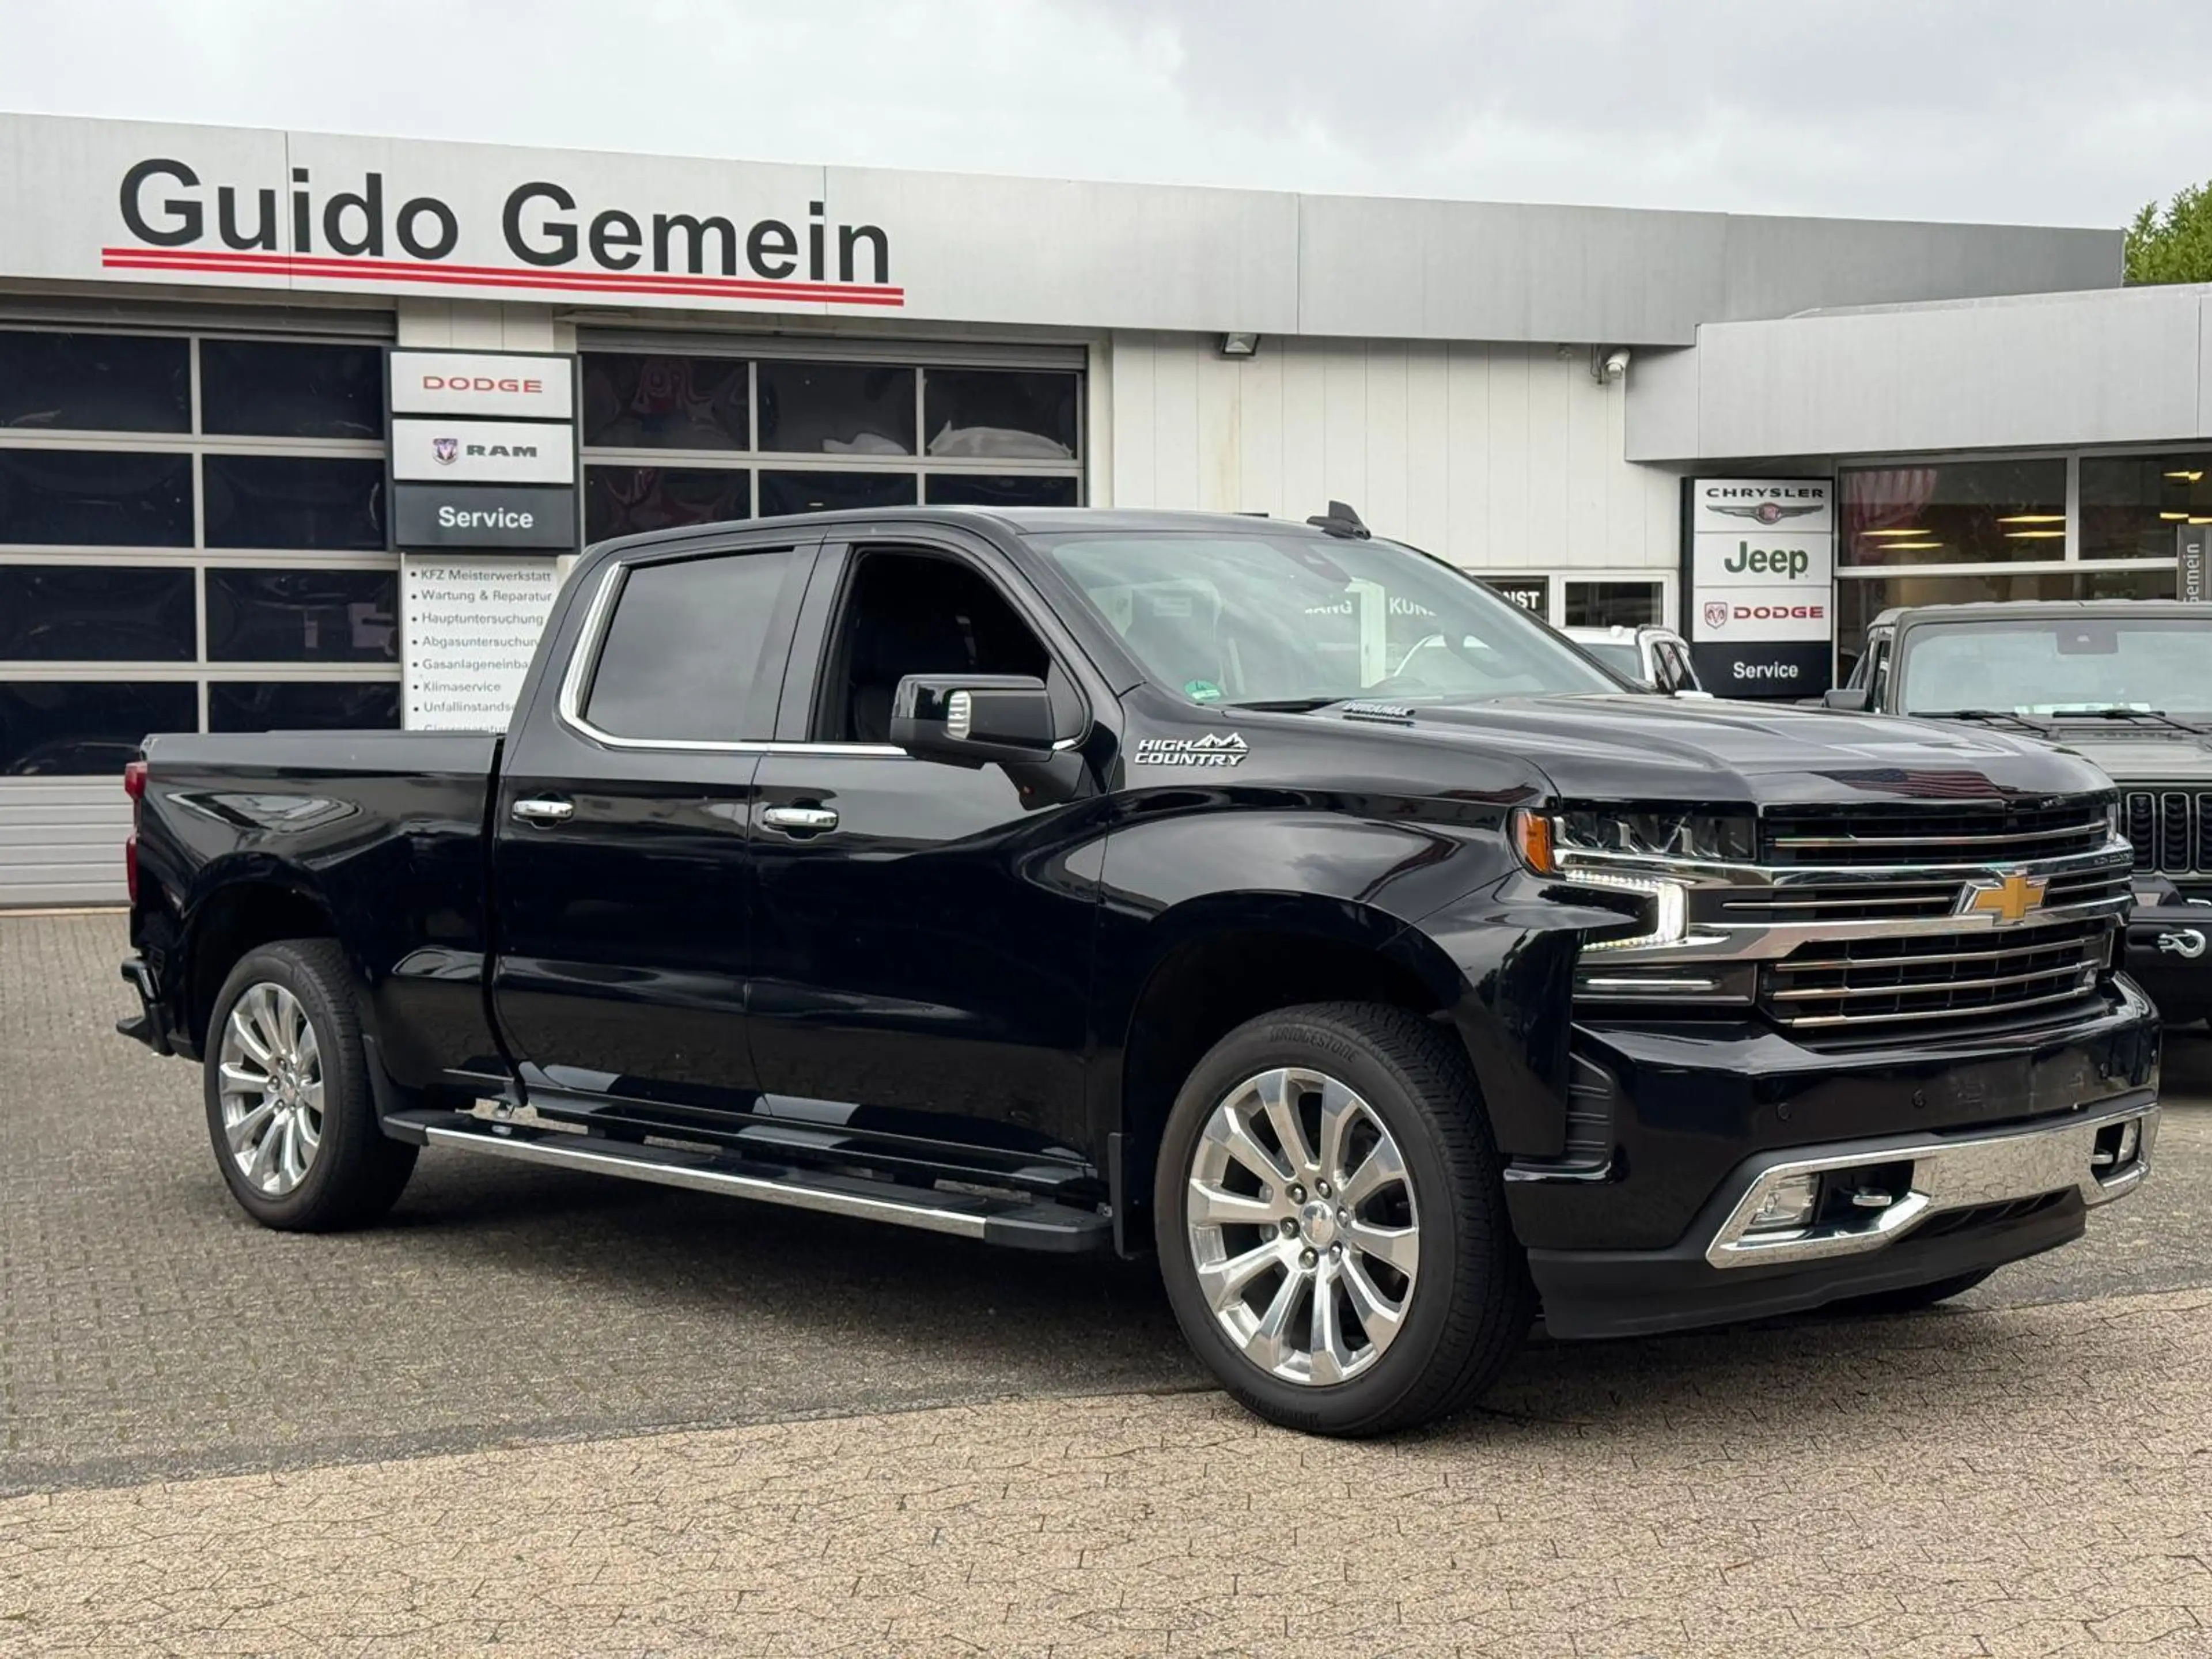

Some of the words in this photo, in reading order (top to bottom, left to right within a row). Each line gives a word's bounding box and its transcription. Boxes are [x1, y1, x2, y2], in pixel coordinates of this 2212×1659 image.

[119, 157, 459, 260] Guido
[502, 180, 889, 285] Gemein
[423, 376, 543, 393] DODGE
[466, 445, 537, 457] RAM
[1706, 487, 1824, 499] CHRYSLER
[438, 506, 533, 528] Service
[1724, 541, 1808, 579] Jeep
[421, 569, 445, 580] KFZ
[448, 570, 551, 582] Meisterwerkstatt
[421, 590, 475, 603] Wartung
[480, 590, 488, 600] &
[493, 591, 552, 603] Reparatur
[422, 612, 543, 626] Hauptuntersuchung
[1733, 607, 1824, 619] DODGE
[422, 658, 529, 672] Gasanlageneinba
[1733, 661, 1798, 679] Service
[423, 680, 501, 692] Klimaservice
[1138, 740, 1194, 751] HIGH
[1134, 752, 1246, 766] COUNTRY
[1270, 1026, 1359, 1063] BRIDGESTONE
